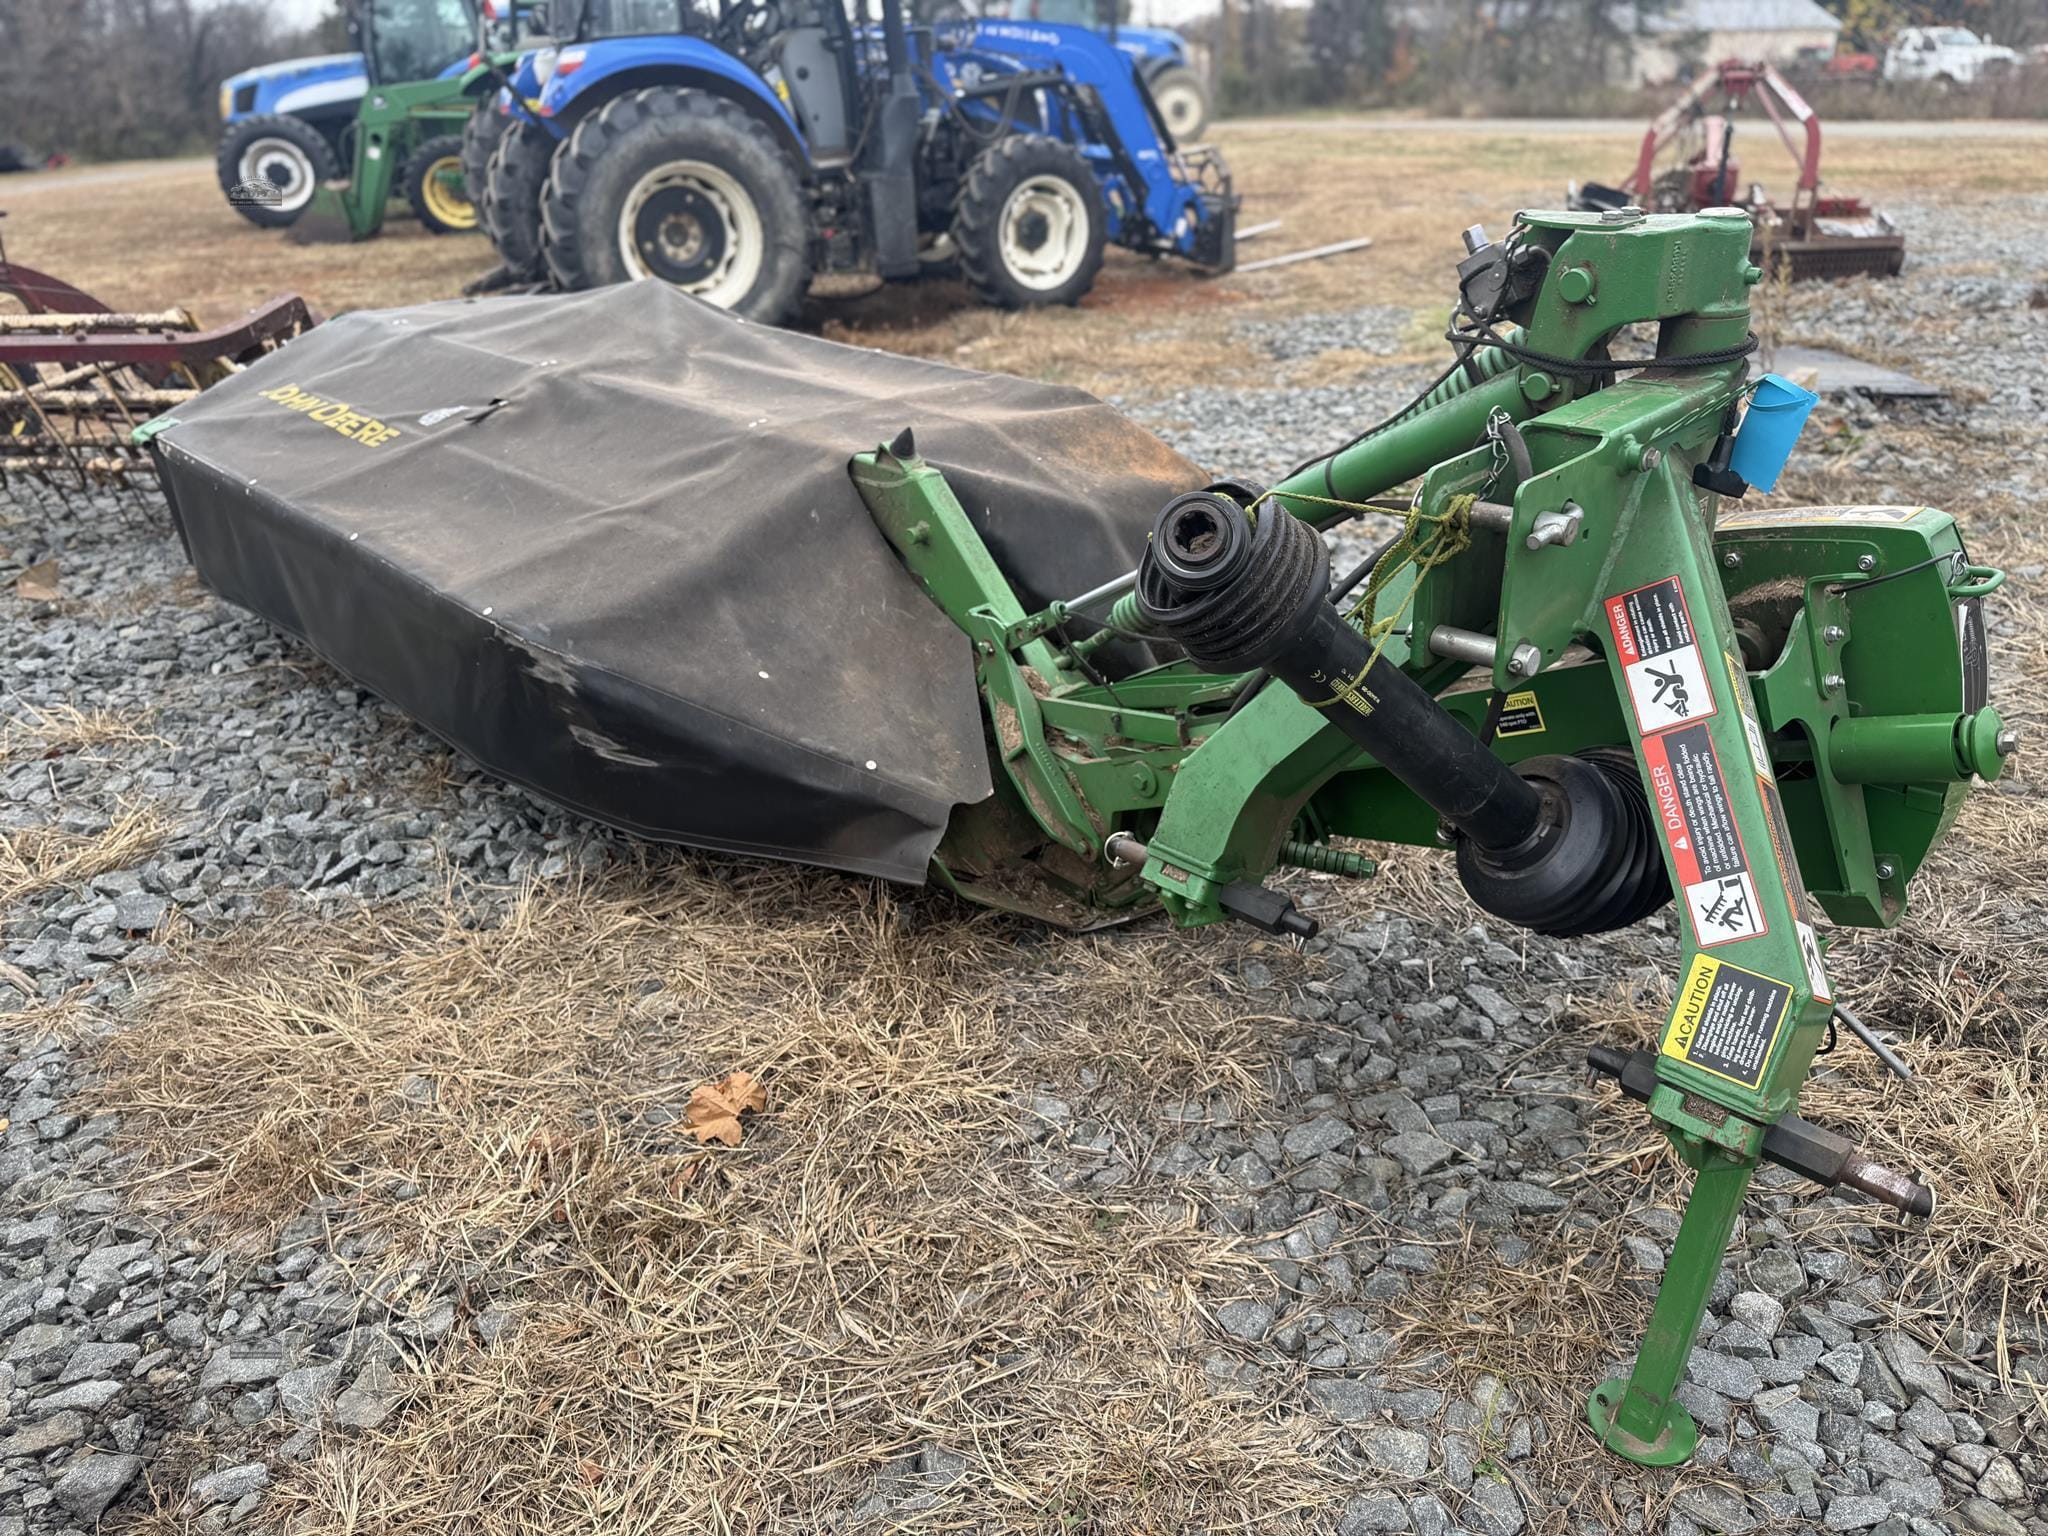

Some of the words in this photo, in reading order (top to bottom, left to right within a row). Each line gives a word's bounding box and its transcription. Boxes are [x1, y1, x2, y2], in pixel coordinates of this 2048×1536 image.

[258, 383, 323, 411] JOHN
[307, 403, 401, 447] DEERE
[1610, 603, 1634, 648] DANGER
[1504, 697, 1534, 708] AUTION
[1678, 743, 1690, 764] folded
[1700, 749, 1714, 774] rapidly.
[1673, 762, 1684, 779] clear
[1685, 763, 1697, 783] being
[1691, 753, 1707, 783] hydraulic
[1678, 779, 1690, 798] stand
[1701, 783, 1708, 791] or
[1707, 774, 1716, 785] fall
[1711, 785, 1718, 793] to
[1651, 764, 1682, 830] DANGER
[1694, 795, 1706, 815] wings
[1713, 793, 1725, 813] wings
[1684, 798, 1696, 818] death
[1702, 791, 1719, 829] Mechanical
[1691, 818, 1698, 826] or
[1700, 816, 1710, 834] when
[1719, 813, 1730, 832] allow
[1692, 826, 1705, 845] injury
[1714, 830, 1728, 861] unfolded.
[1725, 832, 1734, 845] can
[1697, 845, 1709, 865] avoid
[1705, 835, 1719, 864] machine
[1728, 846, 1740, 867] failure
[1703, 864, 1712, 874] To
[1714, 864, 1721, 872] of
[1723, 861, 1731, 870] or
[1678, 965, 1713, 1036] CAUTION
[1764, 988, 1777, 1013] machine
[1695, 1033, 1705, 1048] Keep
[1703, 1006, 1714, 1026] shields
[1712, 984, 1722, 1001] place.
[1700, 1021, 1717, 1051] Disengage
[1711, 1010, 1719, 1022] and
[1715, 998, 1724, 1011] shut
[1708, 1034, 1719, 1053] engine
[1714, 1015, 1725, 1034] and/or
[1721, 999, 1731, 1016] motor
[1727, 981, 1738, 1000] power
[1756, 1012, 1769, 1034] running
[1713, 1037, 1724, 1055] before
[1720, 1012, 1734, 1038] servicing
[1724, 1020, 1737, 1045] machine.
[1725, 1045, 1736, 1060] Keep
[1737, 1015, 1746, 1027] feet
[1742, 1004, 1750, 1015] and
[1740, 1024, 1749, 1038] from
[1751, 1033, 1760, 1049] leave
[1736, 1038, 1745, 1053] away
[1738, 1047, 1748, 1065] driven
[1744, 1031, 1755, 1048] parts.
[1747, 1048, 1755, 1059] not
[1751, 1037, 1766, 1070] unattended.
[1732, 1053, 1740, 1062] ing
[1744, 1058, 1752, 1067] Do
